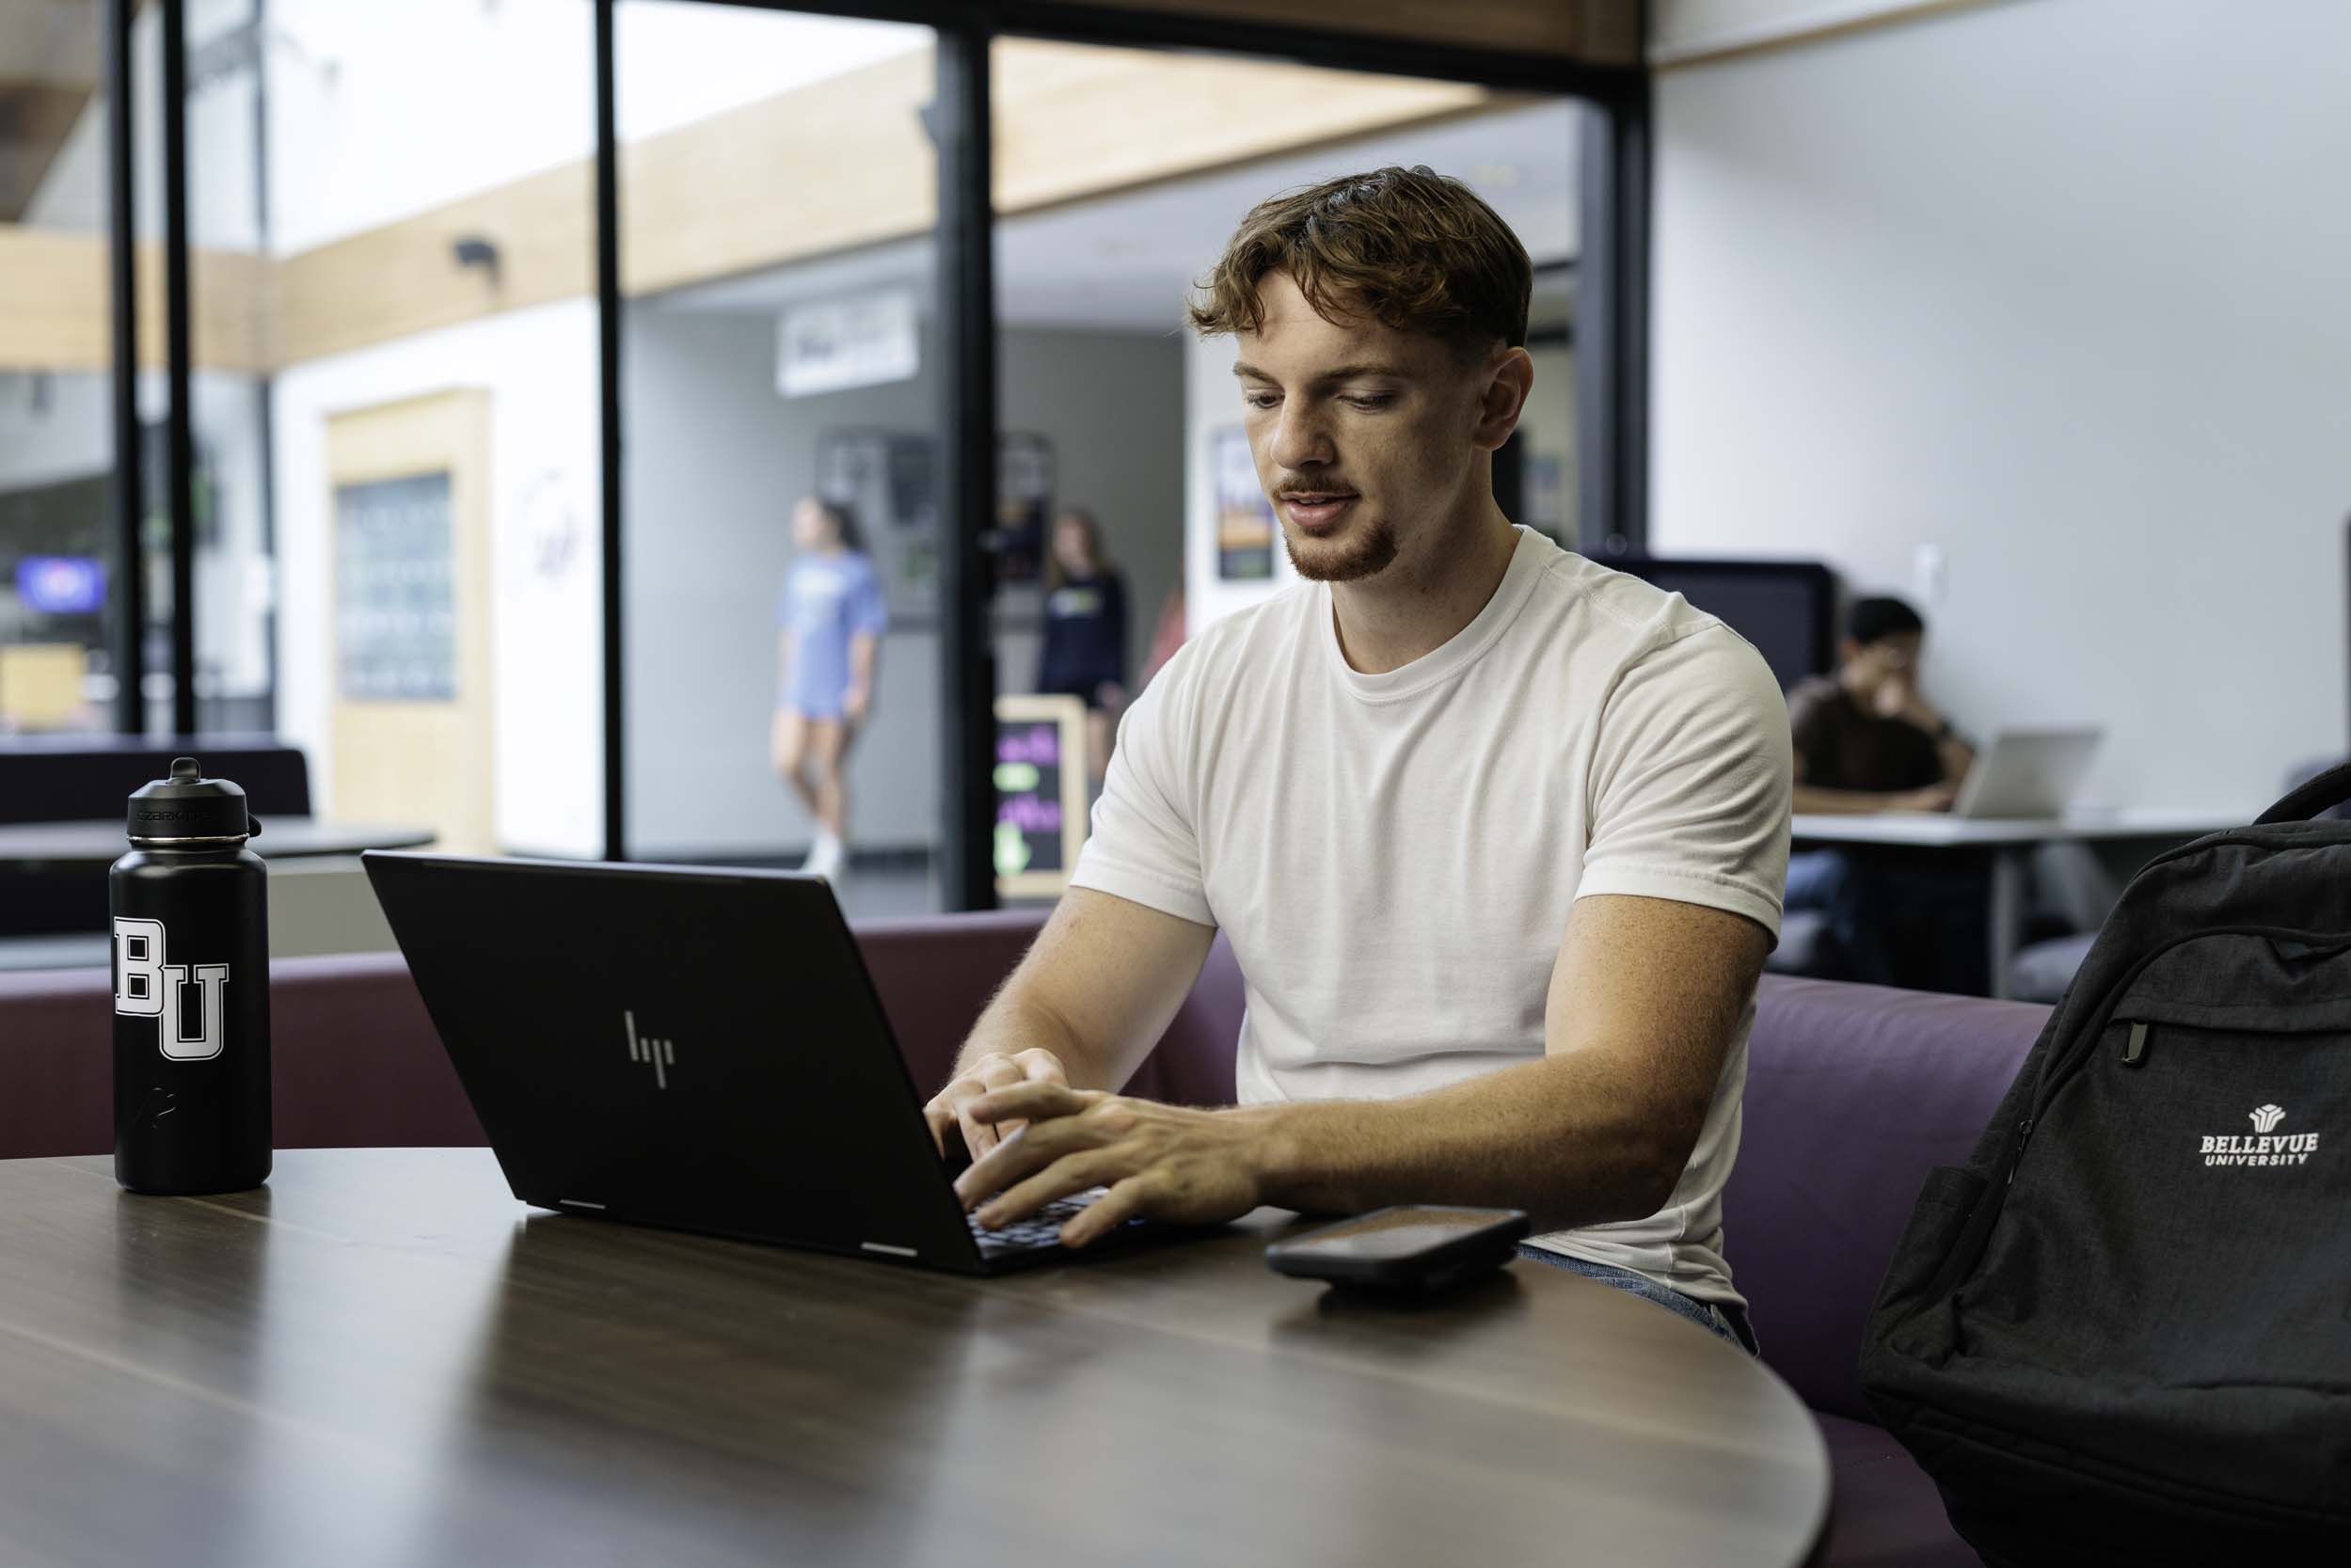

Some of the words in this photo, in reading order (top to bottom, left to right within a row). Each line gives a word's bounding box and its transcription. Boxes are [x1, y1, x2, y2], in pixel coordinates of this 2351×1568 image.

[114, 916, 229, 1061] BU
[2200, 1132, 2319, 1153] BELLEVUE
[2204, 1153, 2309, 1166] UNIVERSITY
